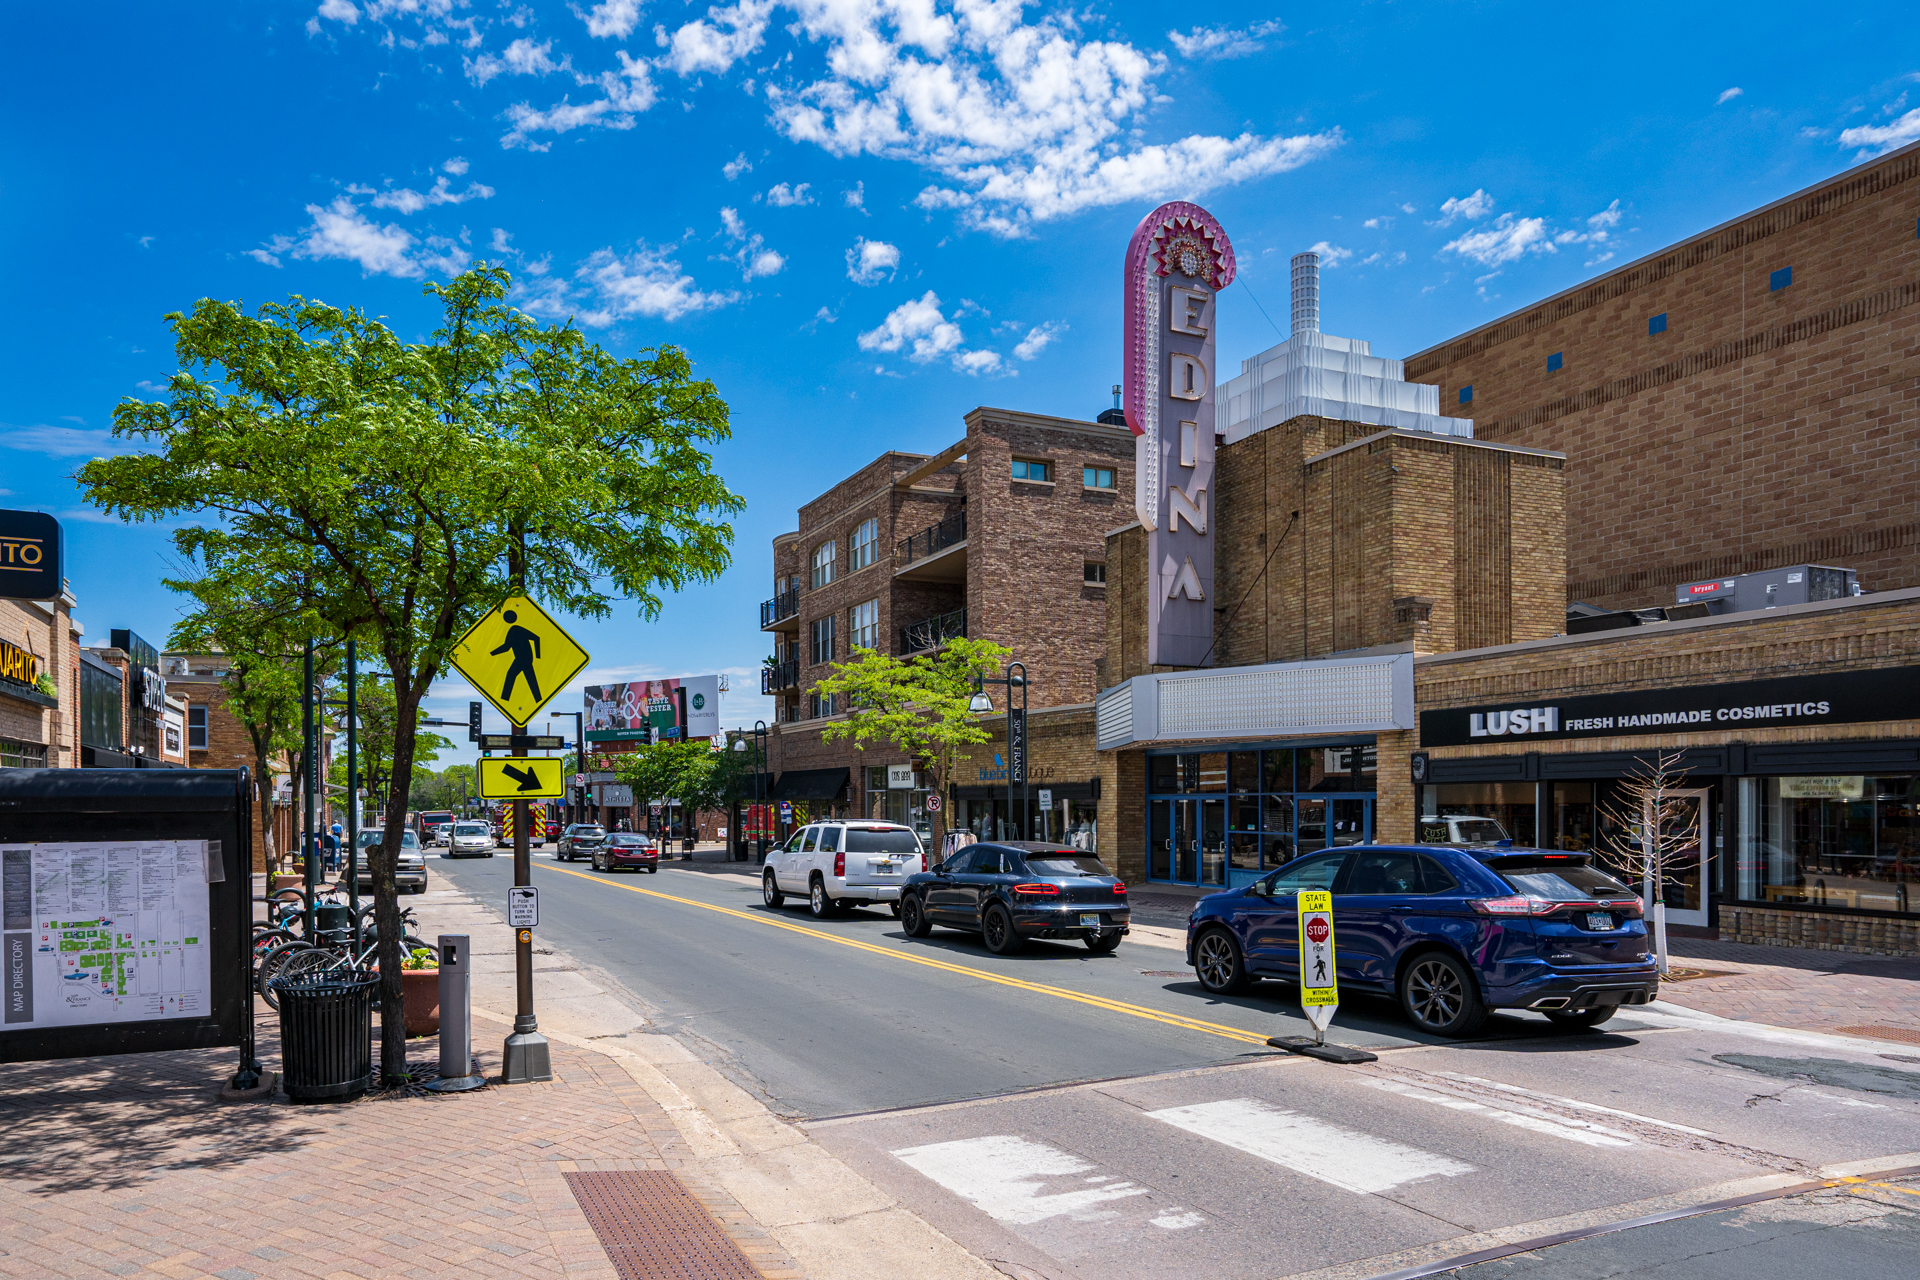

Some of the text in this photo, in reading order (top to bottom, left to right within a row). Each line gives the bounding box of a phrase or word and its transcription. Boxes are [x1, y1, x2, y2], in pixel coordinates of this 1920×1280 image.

[1168, 285, 1209, 601] EDINA
[0, 542, 43, 565] TO
[1695, 584, 1714, 592] bryant
[623, 690, 642, 720] &
[647, 696, 669, 705] TASTE
[594, 707, 618, 715] MAKER
[646, 704, 672, 712] TESTER
[1470, 701, 1830, 737] LUSH FRESH HANDMADE COSMETICS
[1013, 735, 1022, 746] &
[1014, 747, 1022, 783] FRANCE
[891, 770, 911, 781] COS BAR
[1305, 894, 1327, 902] STATE
[1308, 925, 1328, 936] STOP
[13, 939, 24, 1012] MAP DIRECTORY
[1306, 996, 1335, 1004] CROSSWALK
